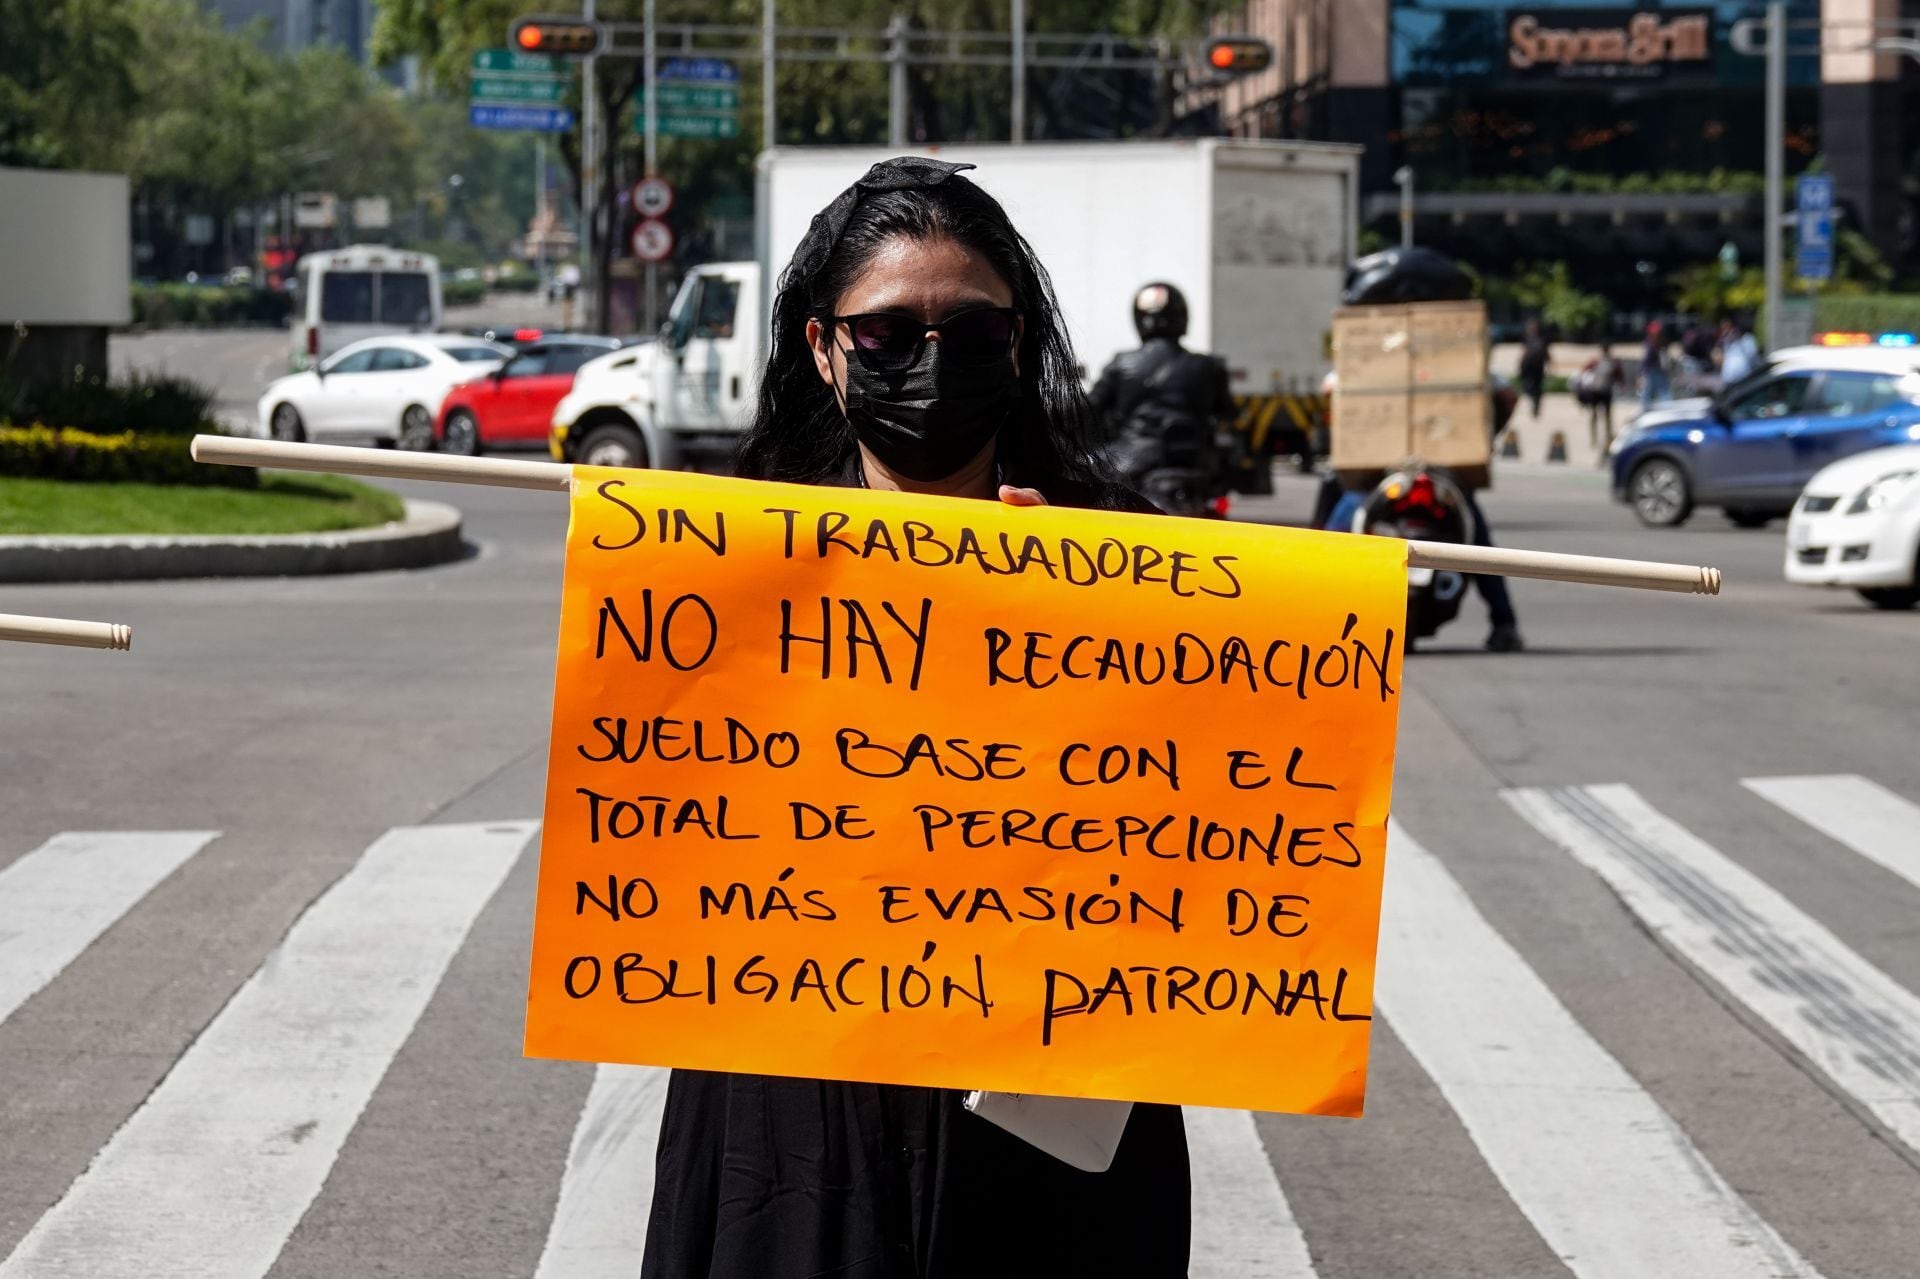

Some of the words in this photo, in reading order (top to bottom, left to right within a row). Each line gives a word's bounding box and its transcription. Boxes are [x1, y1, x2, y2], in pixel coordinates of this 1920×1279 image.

[593, 481, 726, 557] SIN
[763, 508, 1240, 599] TRABAJADORES
[596, 588, 718, 672] NO
[779, 597, 932, 691] HAY
[985, 612, 1394, 702] RECAUDACIÓN
[577, 715, 799, 769] SUELDO
[836, 727, 1026, 782] BASE
[1059, 739, 1180, 791] CON
[1227, 746, 1337, 791] EL
[576, 787, 760, 844] TOTAL
[788, 801, 875, 841] DE
[913, 804, 1362, 869] PERCEPCIONES
[576, 874, 659, 922] NO
[700, 867, 837, 923] MÁS
[879, 873, 1185, 935] EVASIÓN
[1228, 888, 1310, 938] DE
[564, 940, 994, 1018] OBLIGACIÓN
